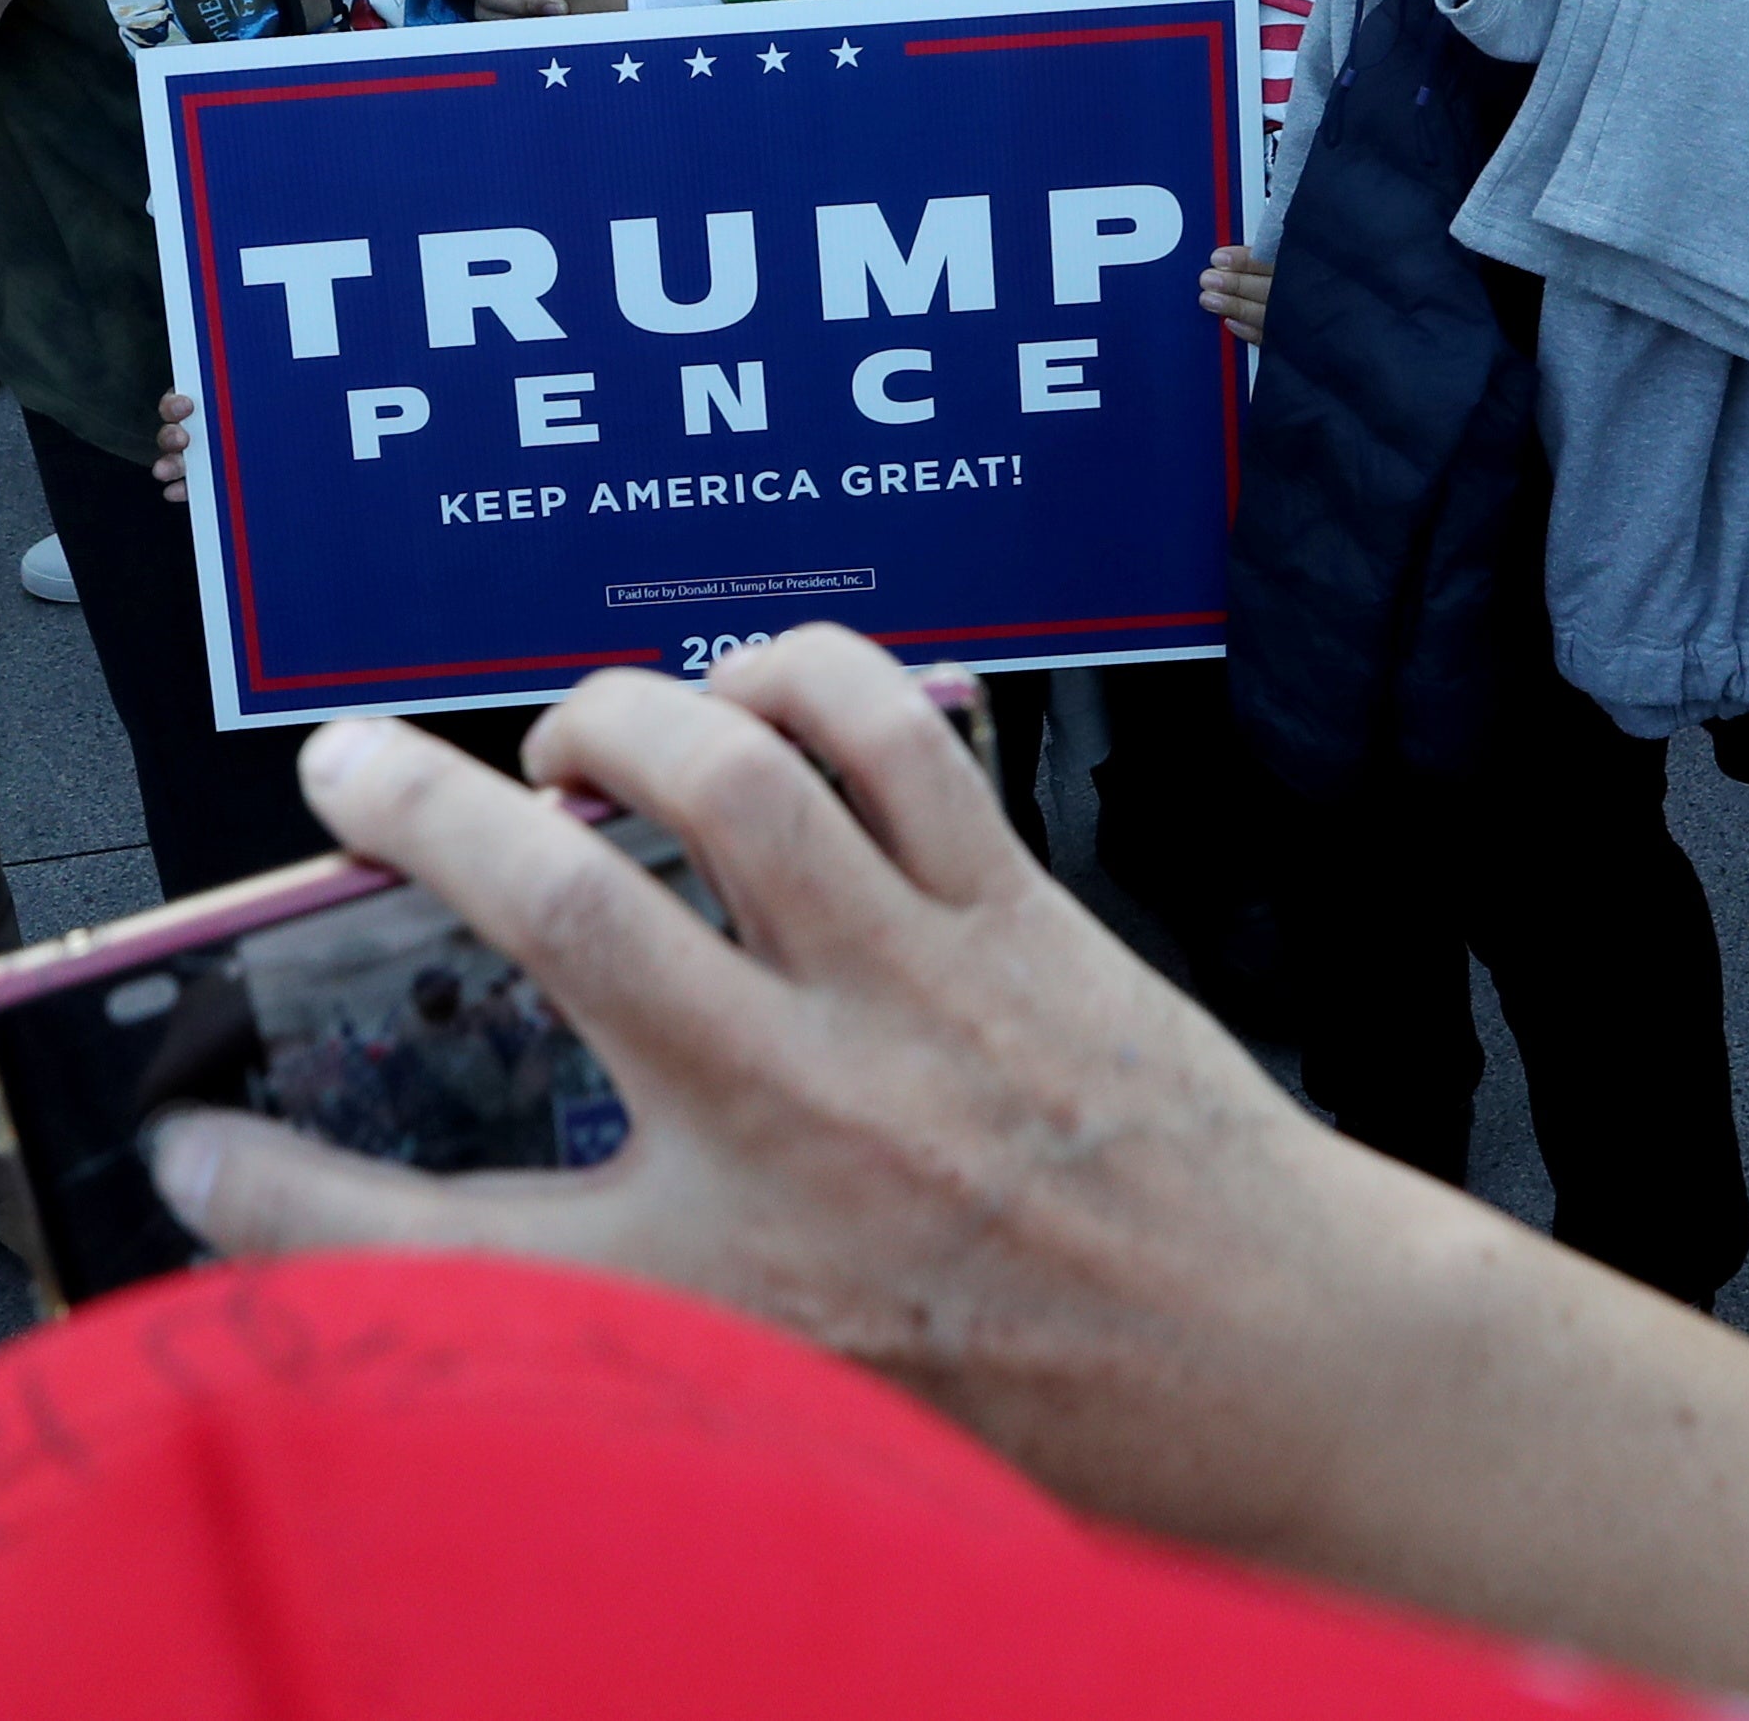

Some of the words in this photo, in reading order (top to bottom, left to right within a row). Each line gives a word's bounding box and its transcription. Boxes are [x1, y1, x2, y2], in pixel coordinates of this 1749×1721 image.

[239, 184, 1185, 359] TRUMP
[347, 338, 1101, 460] PENCE
[440, 483, 567, 525] KEEP
[587, 467, 822, 514] AMERICA
[840, 454, 1024, 496] GREAT!
[618, 589, 642, 601] Paid
[644, 587, 660, 598] for
[662, 586, 676, 600] by
[678, 582, 718, 596] Donald
[720, 581, 728, 595] J.
[730, 581, 767, 595] Trump
[768, 578, 784, 590] for
[786, 575, 841, 590] President,
[843, 573, 864, 586] Inc.
